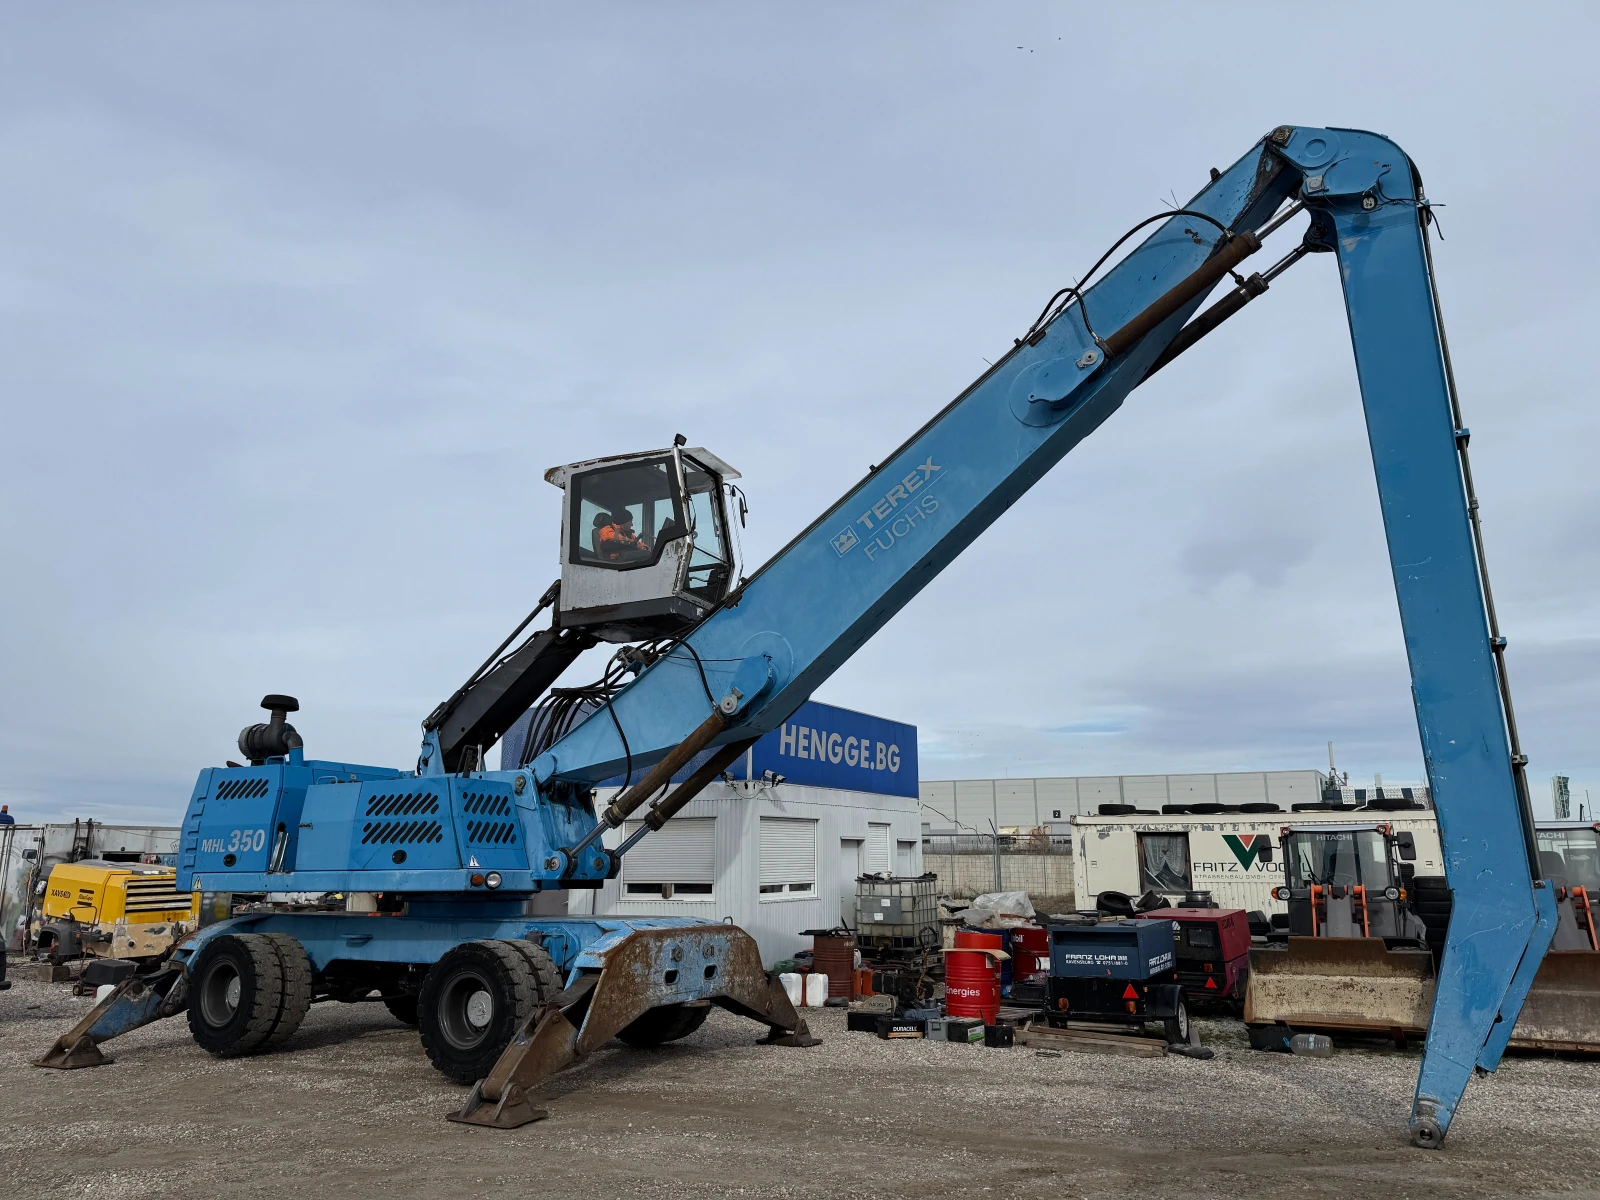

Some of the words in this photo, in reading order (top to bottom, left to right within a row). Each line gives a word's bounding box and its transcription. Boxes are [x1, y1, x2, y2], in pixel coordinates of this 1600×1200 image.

[856, 455, 941, 529] TEREX
[864, 495, 939, 561] FUCHS
[780, 722, 900, 773] HENGGE.BG
[202, 839, 225, 852] MHL
[228, 829, 265, 852] 350
[1193, 862, 1239, 872] FRITZ
